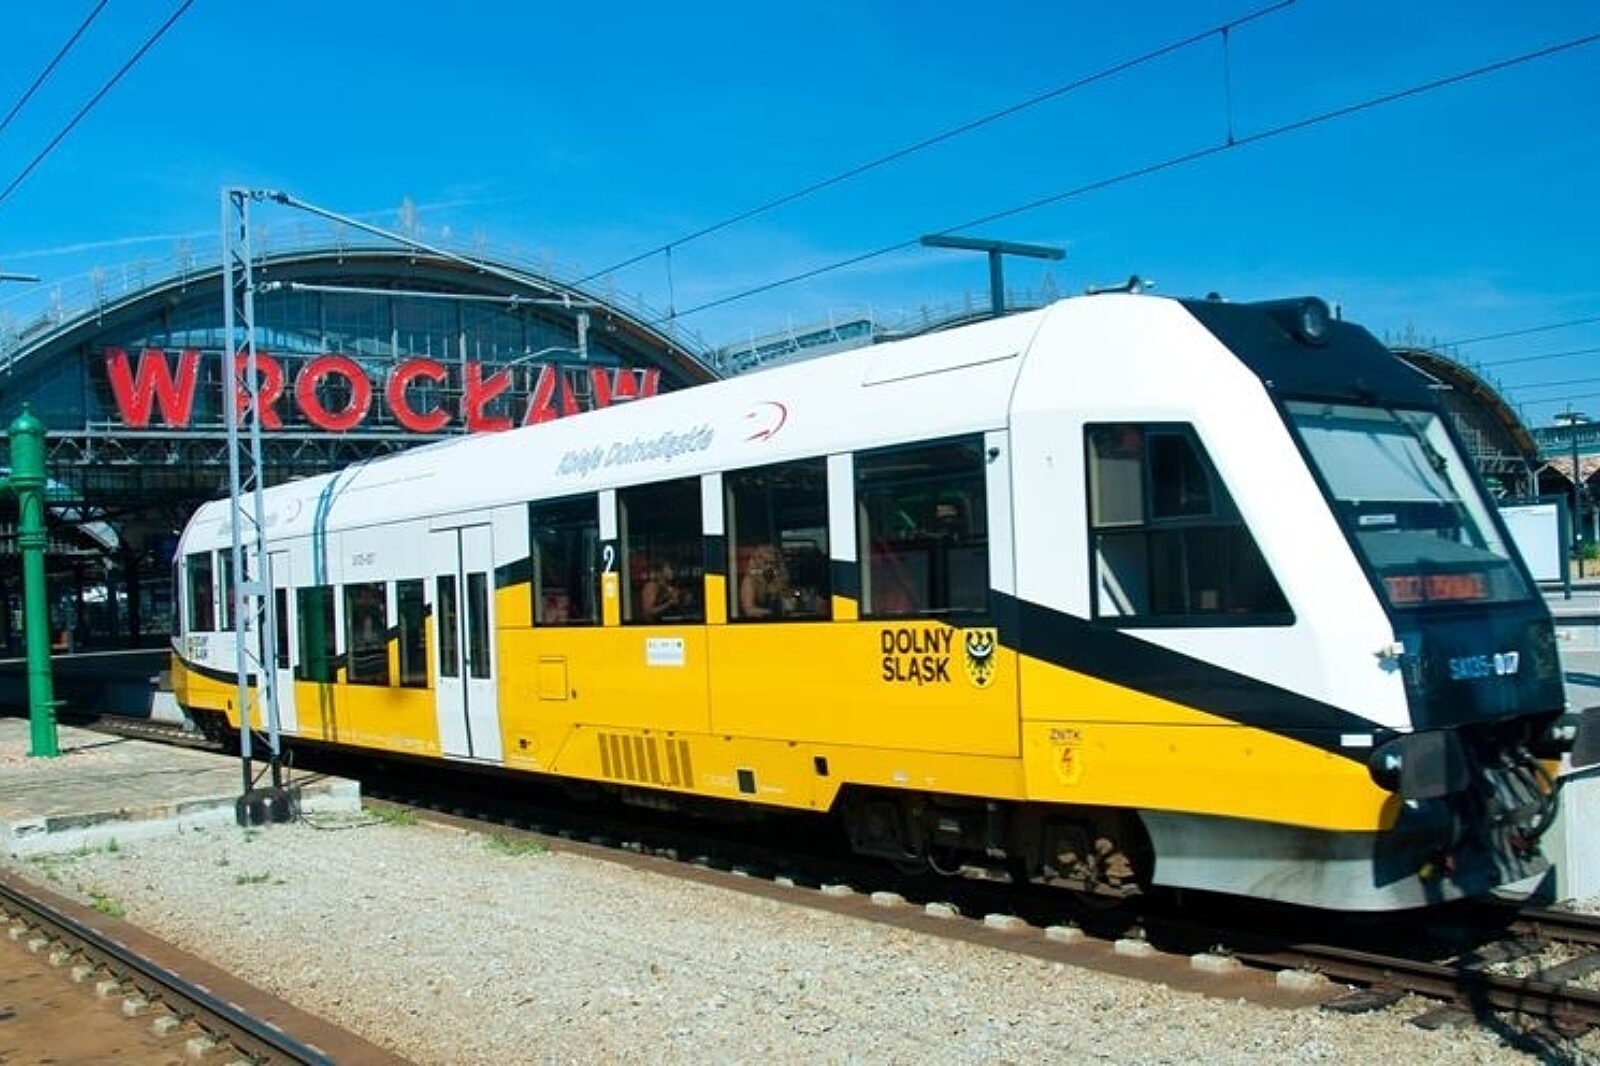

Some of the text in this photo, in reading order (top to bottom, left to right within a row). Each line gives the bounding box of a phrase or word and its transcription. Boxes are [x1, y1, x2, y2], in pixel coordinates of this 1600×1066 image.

[106, 348, 660, 433] WROCŁAW
[603, 545, 614, 574] 2
[881, 628, 954, 654] DOLNY
